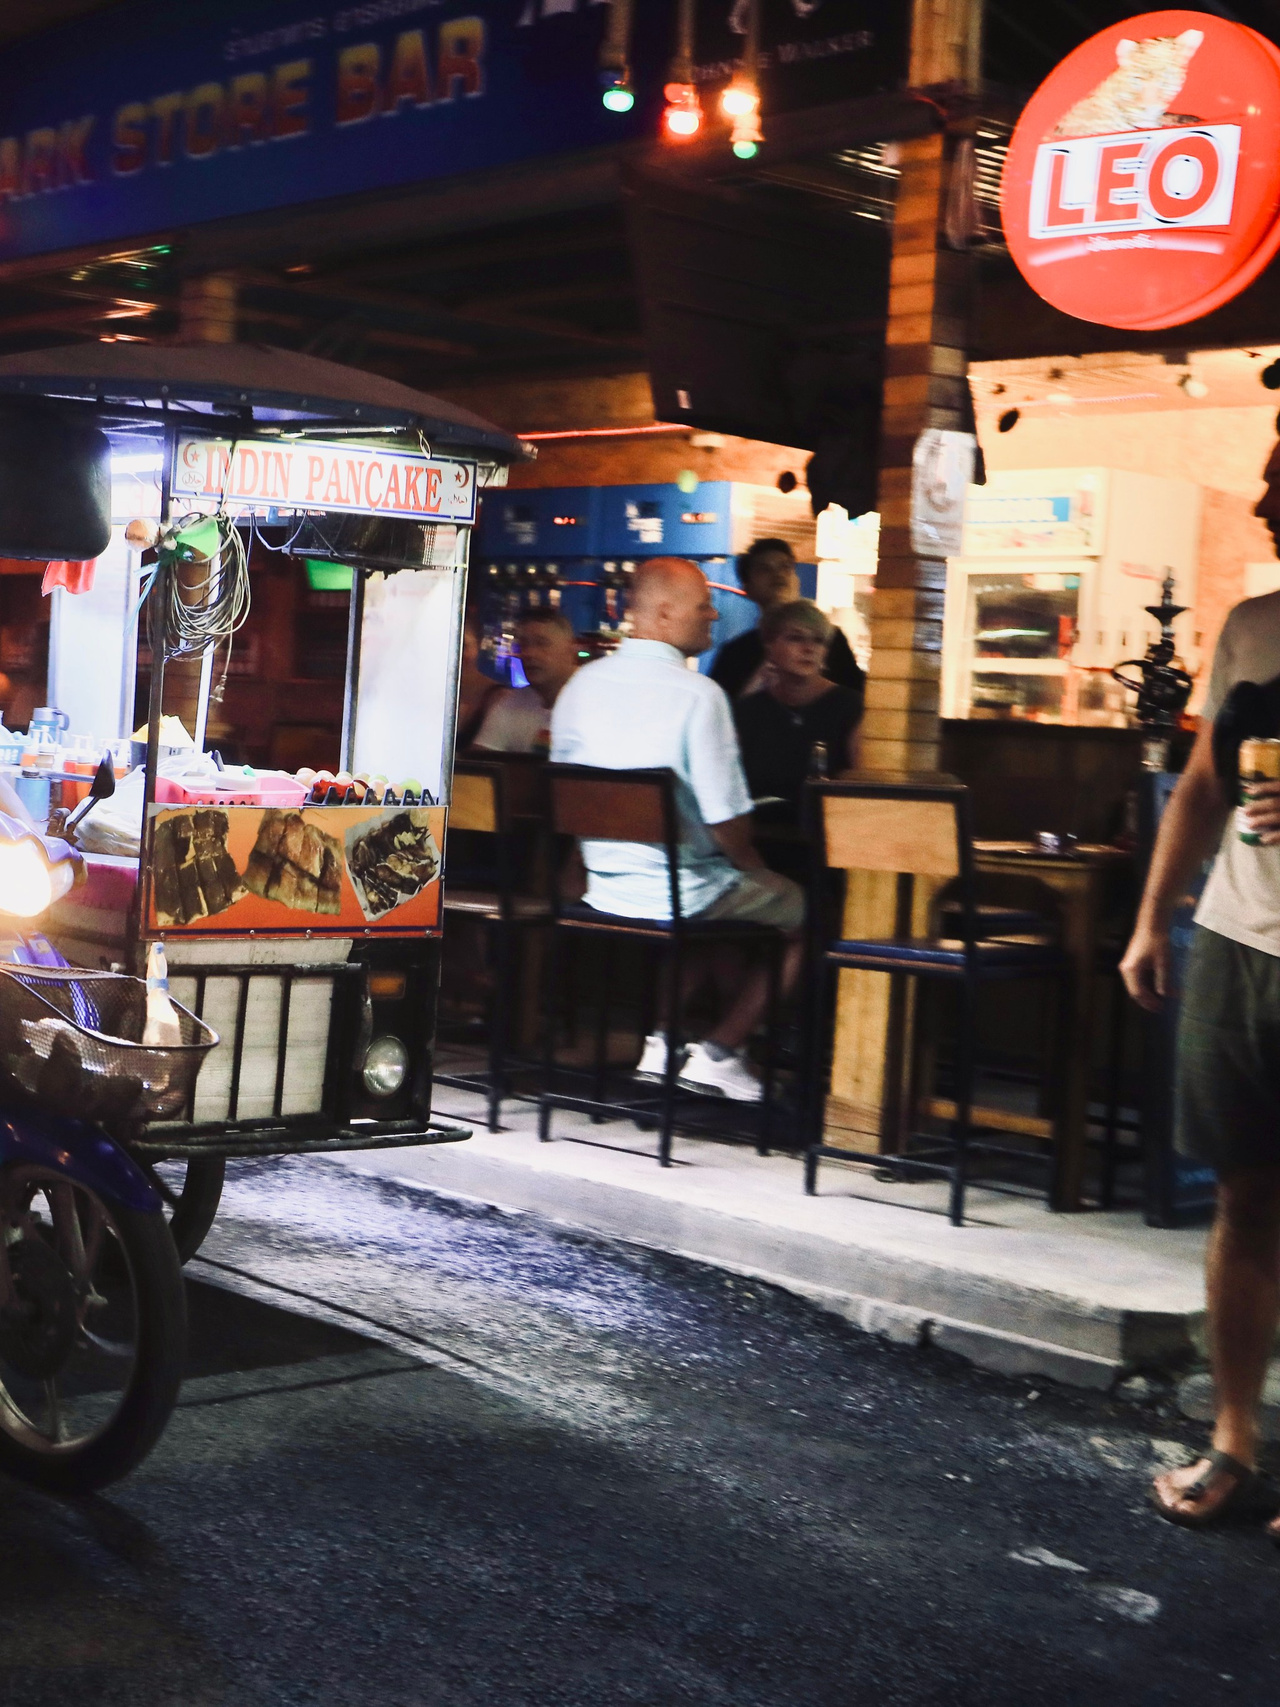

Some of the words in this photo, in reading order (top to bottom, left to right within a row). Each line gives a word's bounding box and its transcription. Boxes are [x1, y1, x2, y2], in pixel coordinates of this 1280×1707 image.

[111, 56, 314, 177] STORE
[335, 15, 487, 128] BAR
[1046, 135, 1220, 229] LEO
[202, 444, 294, 498] INDIN
[304, 454, 443, 513] PANCAKE
